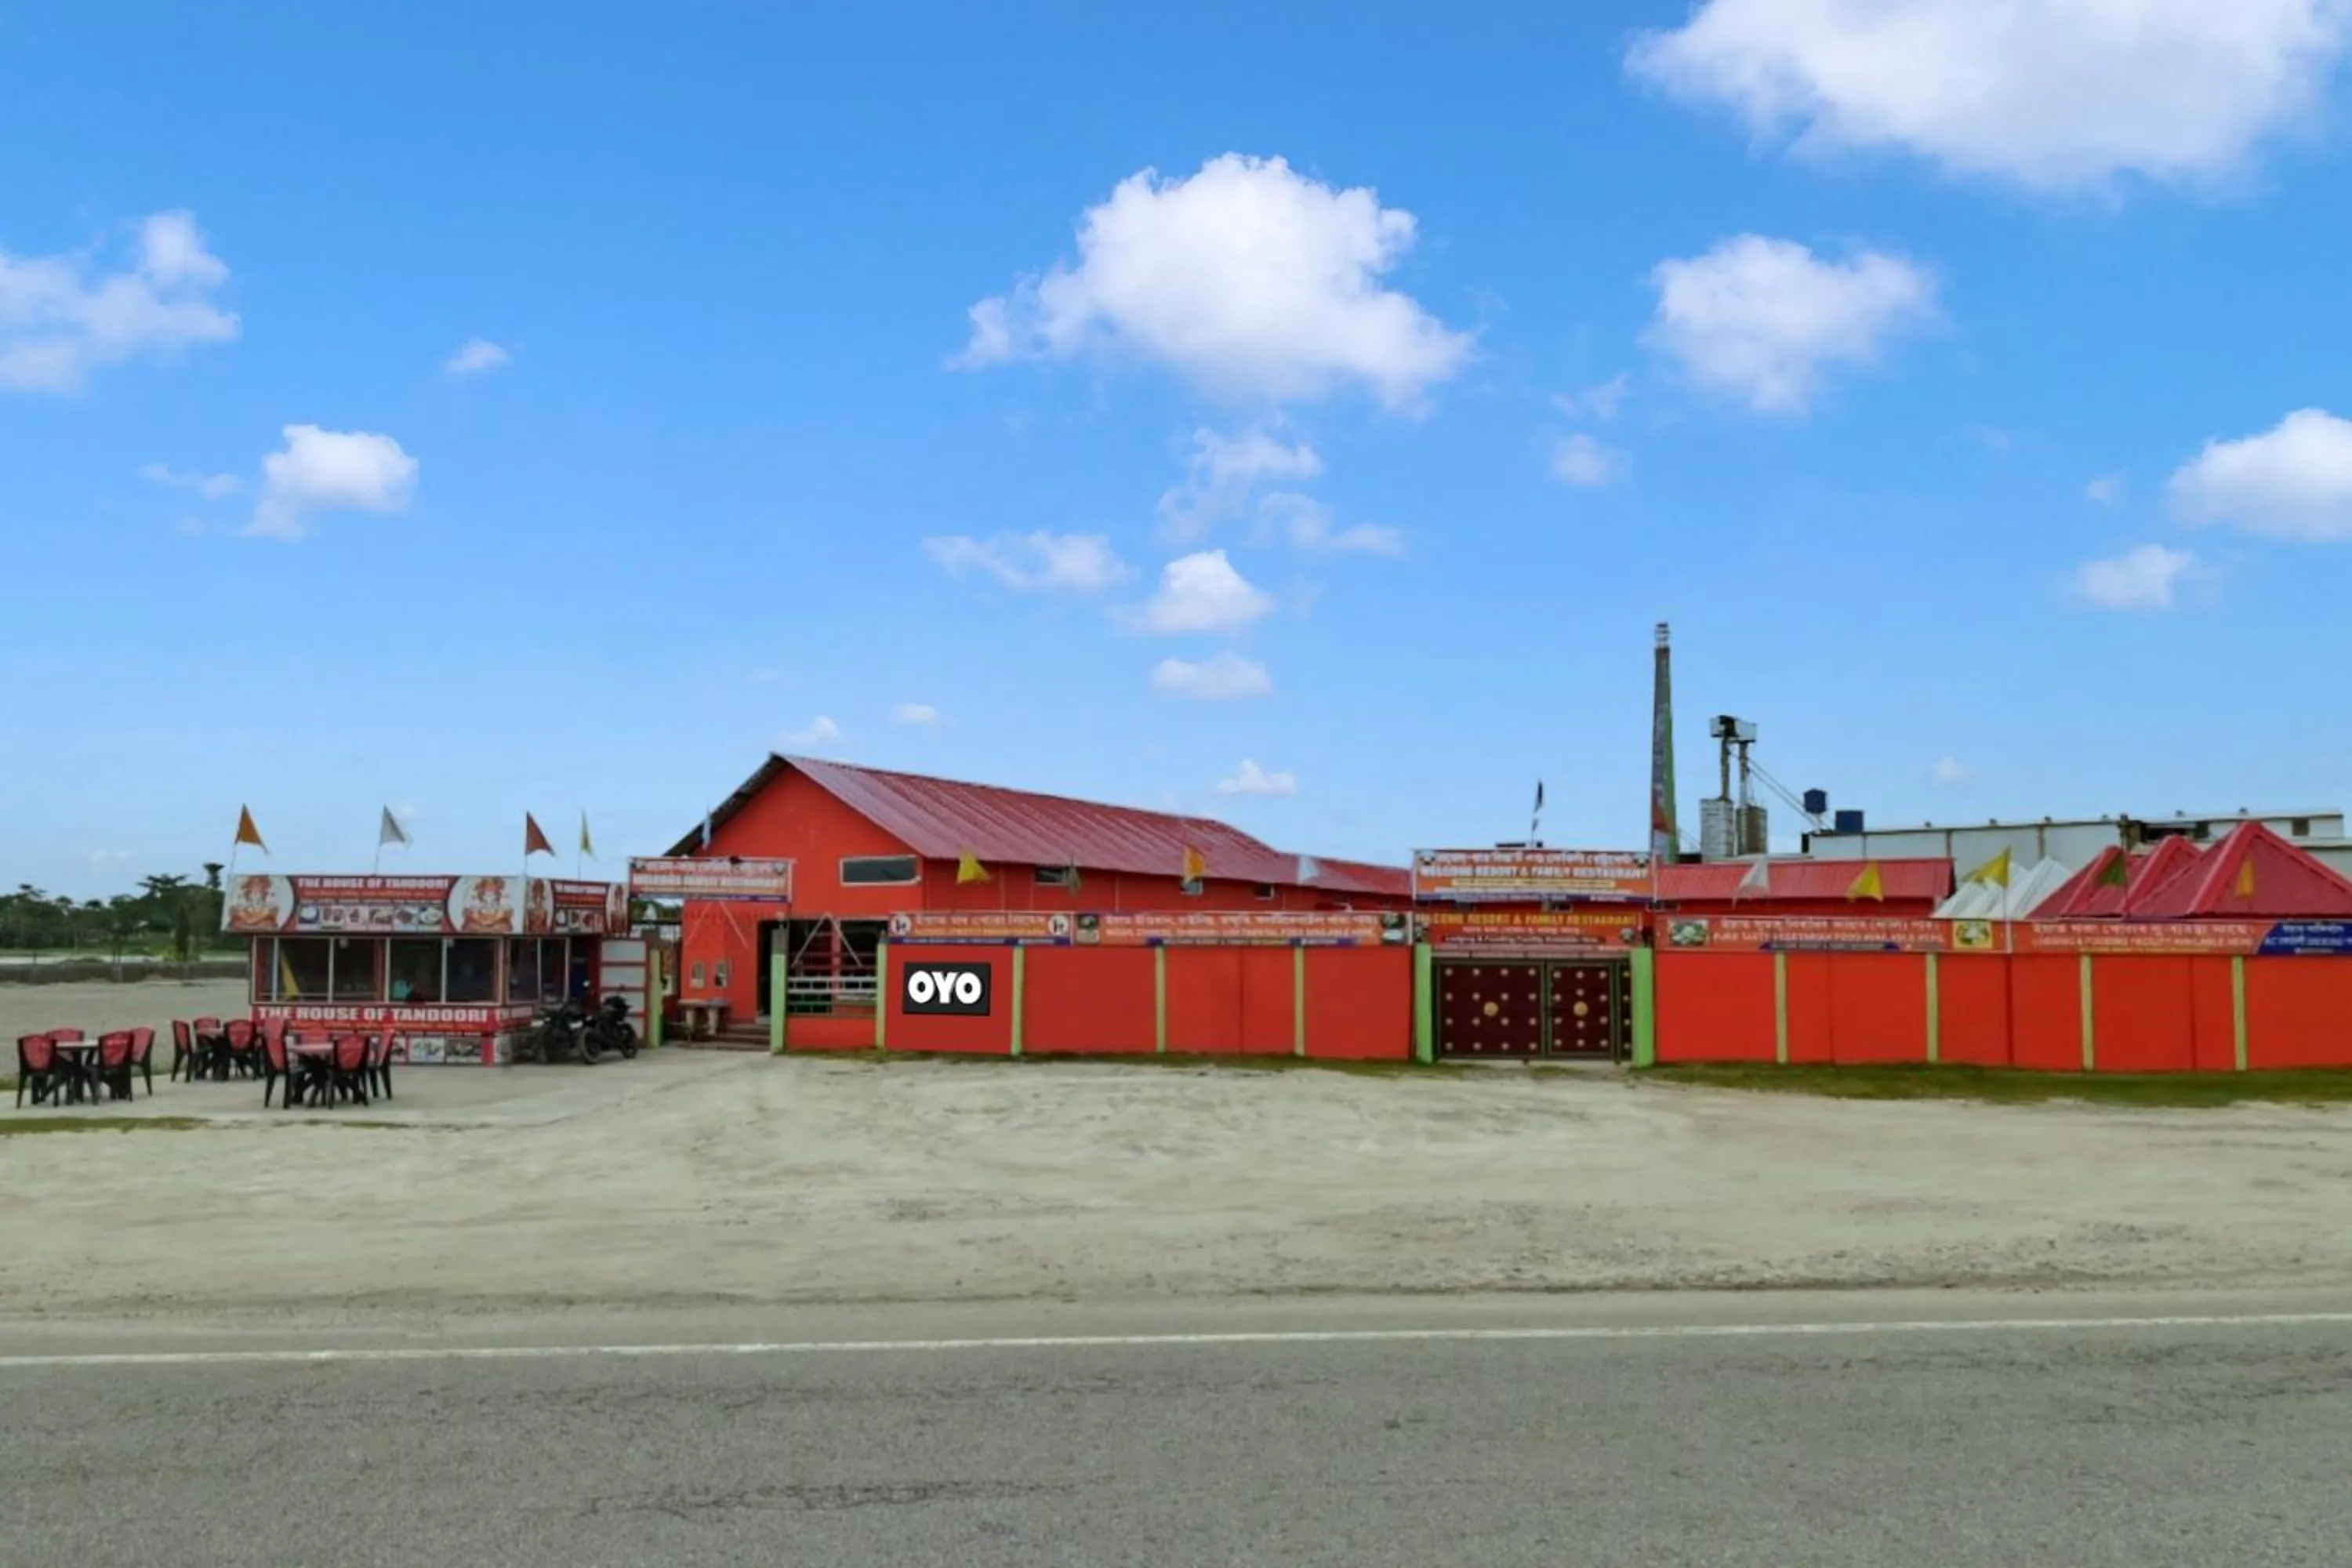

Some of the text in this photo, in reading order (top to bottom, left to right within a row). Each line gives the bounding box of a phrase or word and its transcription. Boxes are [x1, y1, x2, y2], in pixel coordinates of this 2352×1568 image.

[908, 971, 982, 1004] OYO
[260, 1007, 291, 1019] THE
[297, 1007, 358, 1020] HOUSE
[364, 1008, 386, 1021] OF
[393, 1008, 487, 1022] TANDOORI
